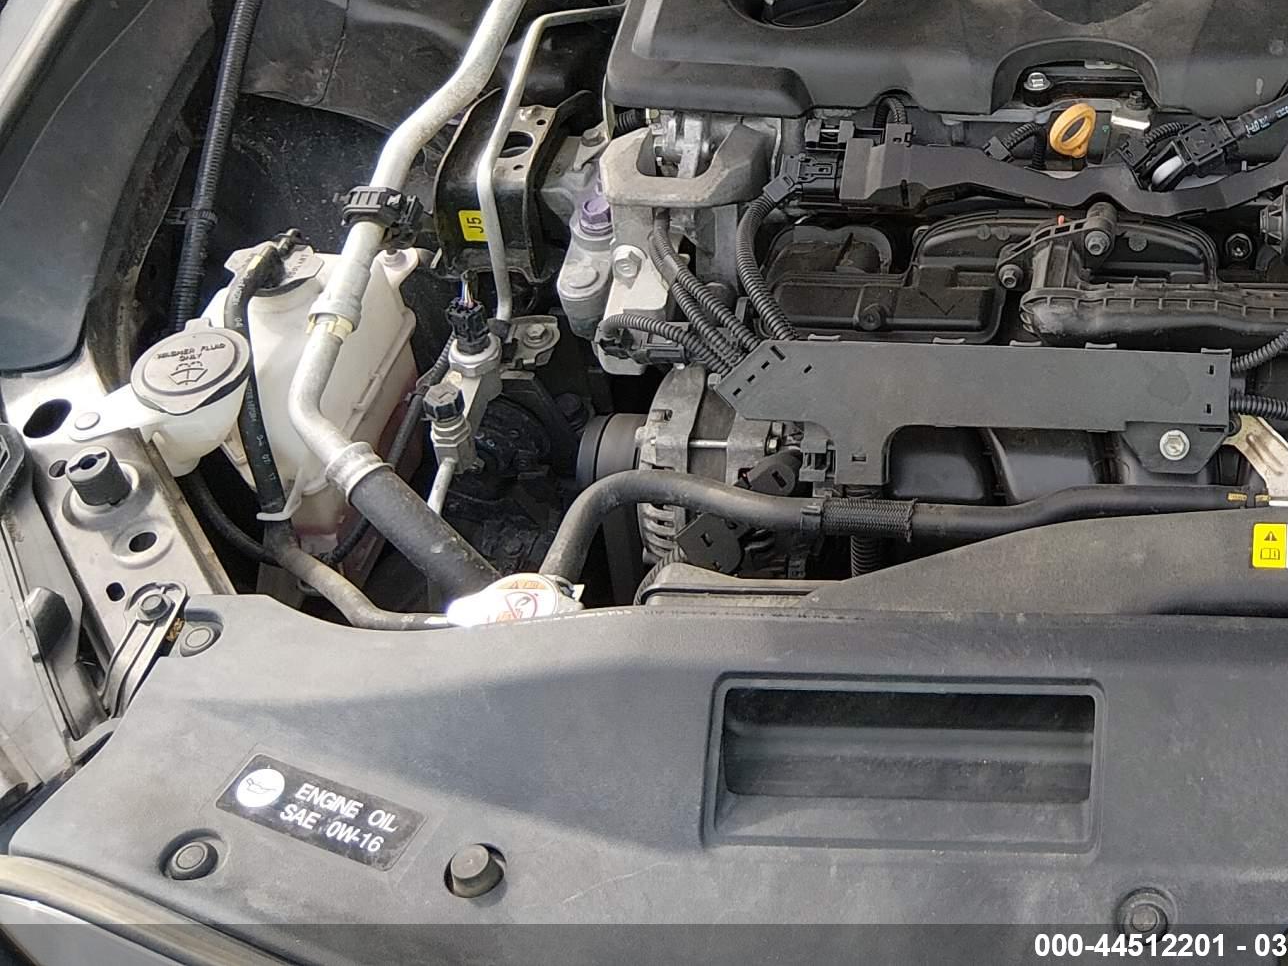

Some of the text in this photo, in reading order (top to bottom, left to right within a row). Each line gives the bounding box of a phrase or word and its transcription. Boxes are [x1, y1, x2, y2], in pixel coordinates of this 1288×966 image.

[280, 803, 385, 852] SAE 0W-16
[295, 782, 399, 833] ENGINE OIL
